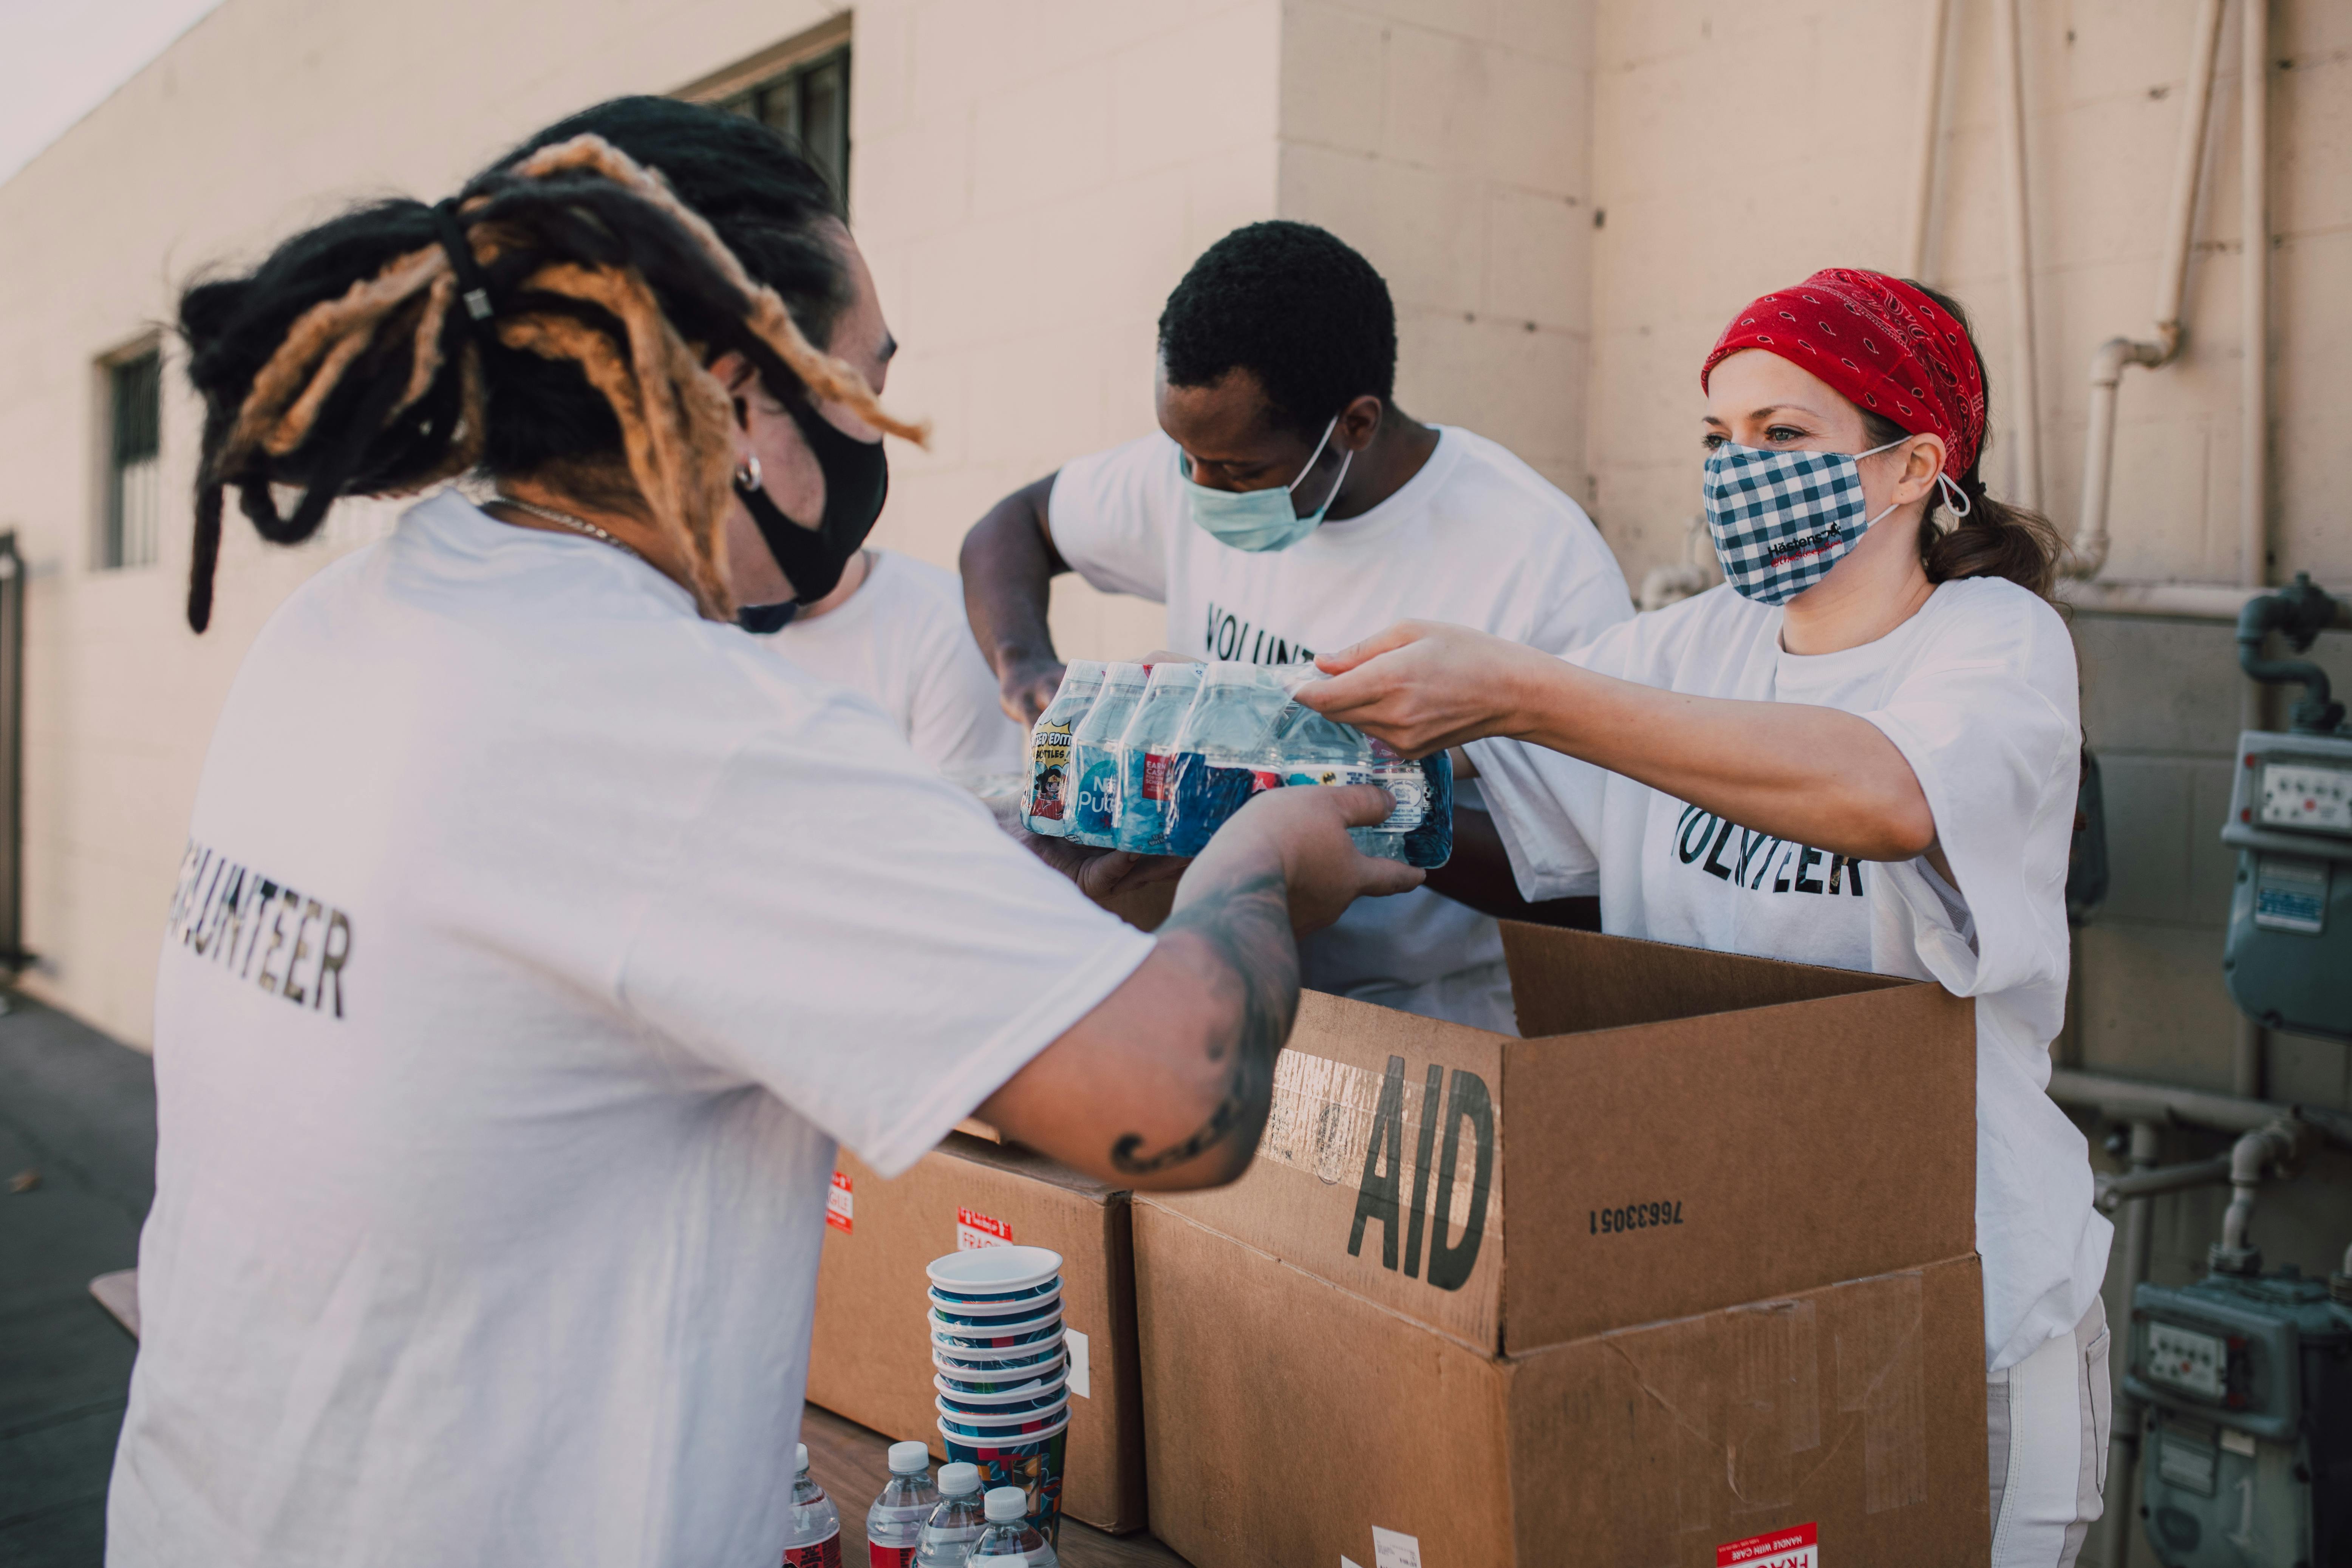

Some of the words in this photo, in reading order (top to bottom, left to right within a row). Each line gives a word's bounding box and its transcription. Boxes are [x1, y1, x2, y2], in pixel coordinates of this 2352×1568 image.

[1767, 533, 1823, 558] Hästens
[1347, 1055, 1494, 1291] AID
[1590, 1200, 1684, 1236] 76633051
[1754, 1543, 1772, 1556] WITH
[1772, 1534, 1802, 1551] HANDLE
[1732, 1547, 1753, 1561] CARE
